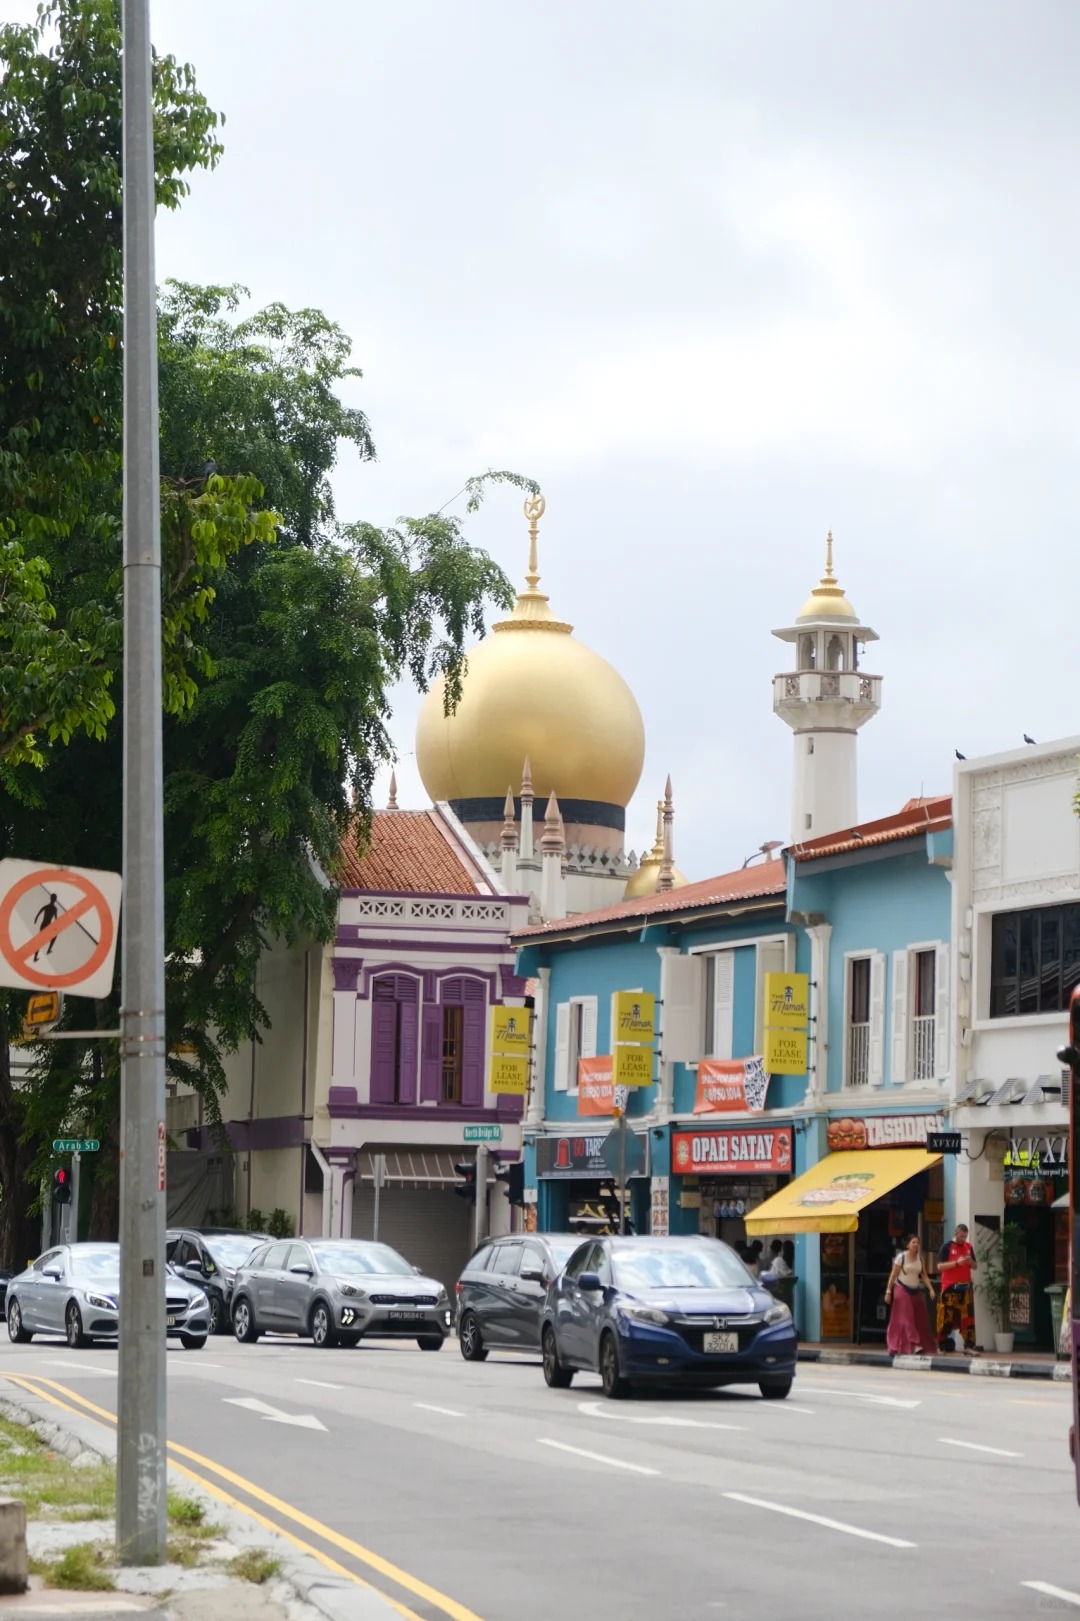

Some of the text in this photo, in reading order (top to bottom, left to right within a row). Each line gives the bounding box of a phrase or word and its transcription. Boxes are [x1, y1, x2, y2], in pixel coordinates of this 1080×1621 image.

[778, 1040, 796, 1048] FOR
[773, 1049, 802, 1058] LEASE
[626, 1054, 644, 1063] FOR
[501, 1064, 518, 1072] FOR
[622, 1062, 648, 1072] LEASE
[496, 1072, 522, 1080] LEASE
[58, 1141, 96, 1150] Arab St
[692, 1133, 774, 1162] OPAH SATAY
[932, 1138, 960, 1148] XVXII
[712, 1333, 730, 1342] SKZ
[706, 1342, 736, 1352] 3201A
